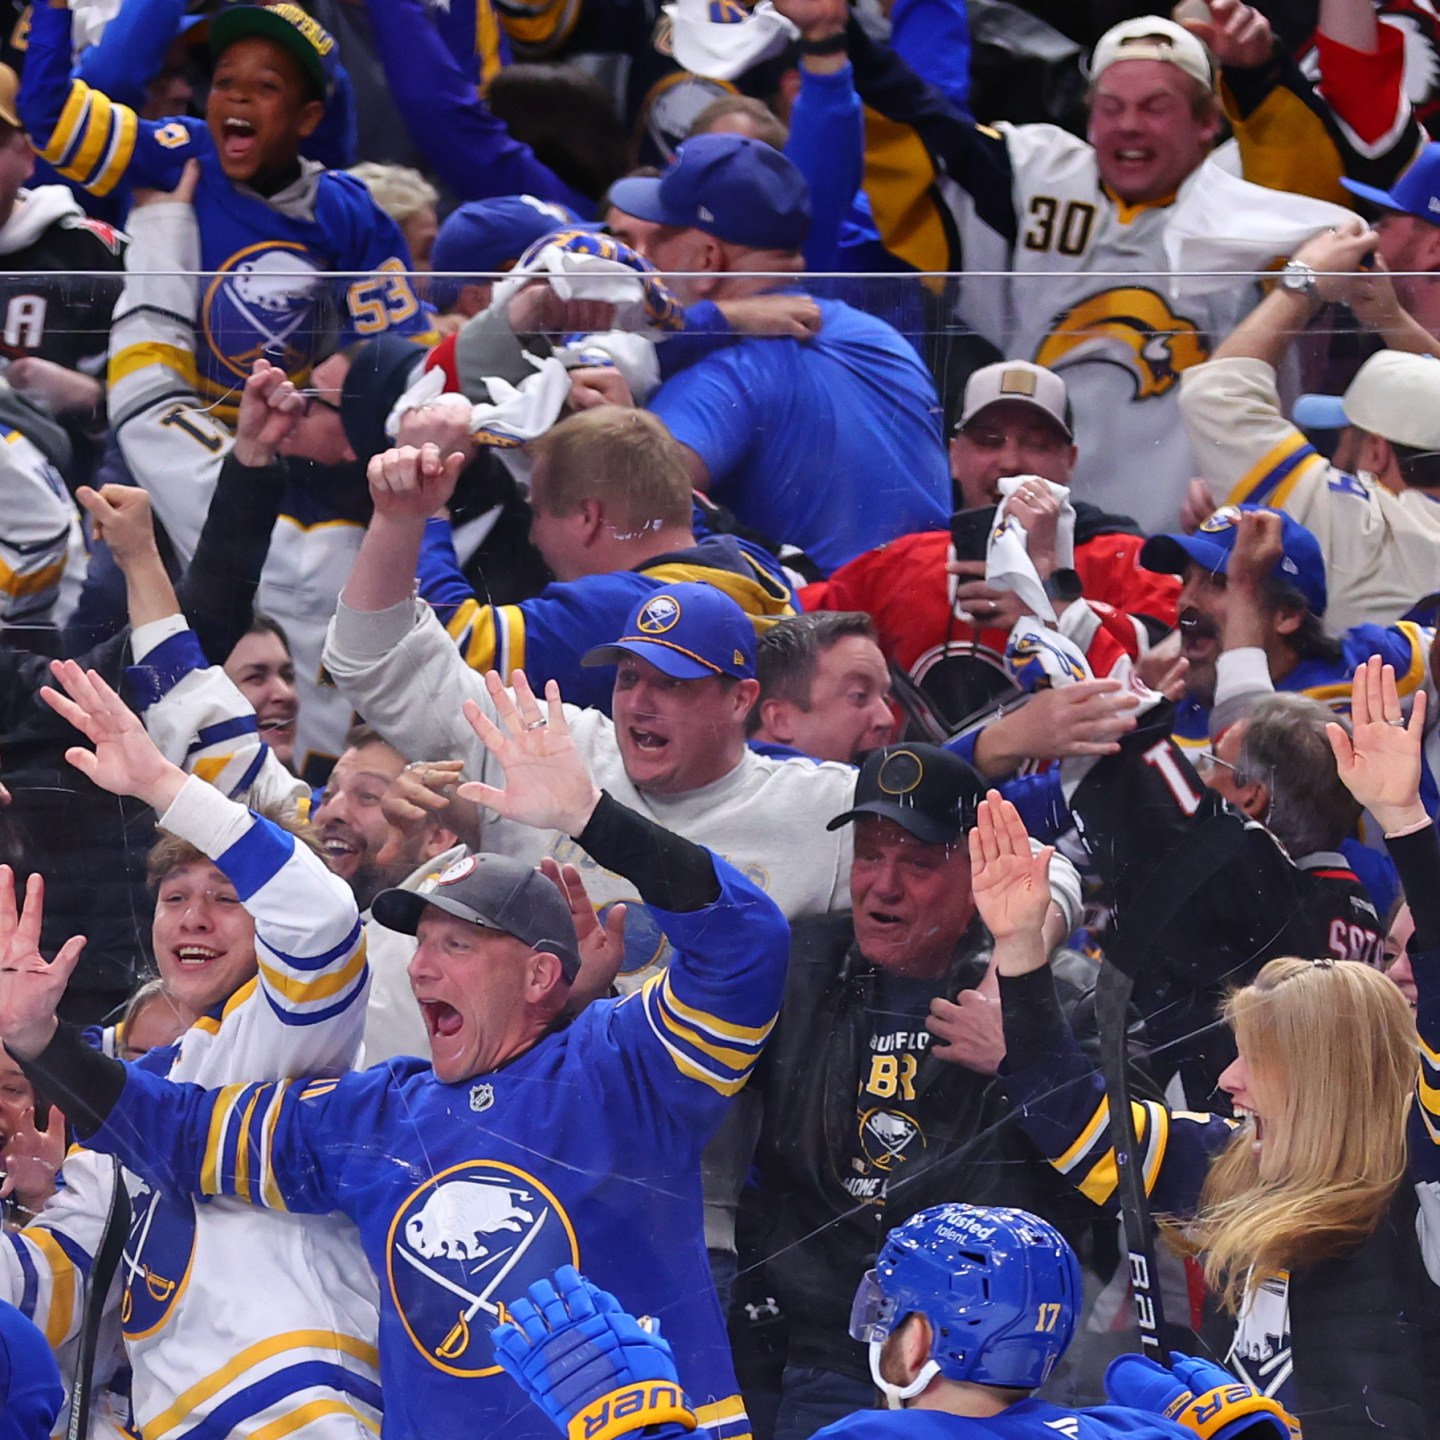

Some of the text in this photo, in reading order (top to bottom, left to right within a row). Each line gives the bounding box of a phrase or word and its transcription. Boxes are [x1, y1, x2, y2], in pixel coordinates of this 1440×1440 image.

[1024, 196, 1097, 257] 30
[3, 294, 47, 348] A
[347, 256, 417, 335] 53
[937, 1208, 997, 1240] Trusted
[1034, 1303, 1061, 1332] 17
